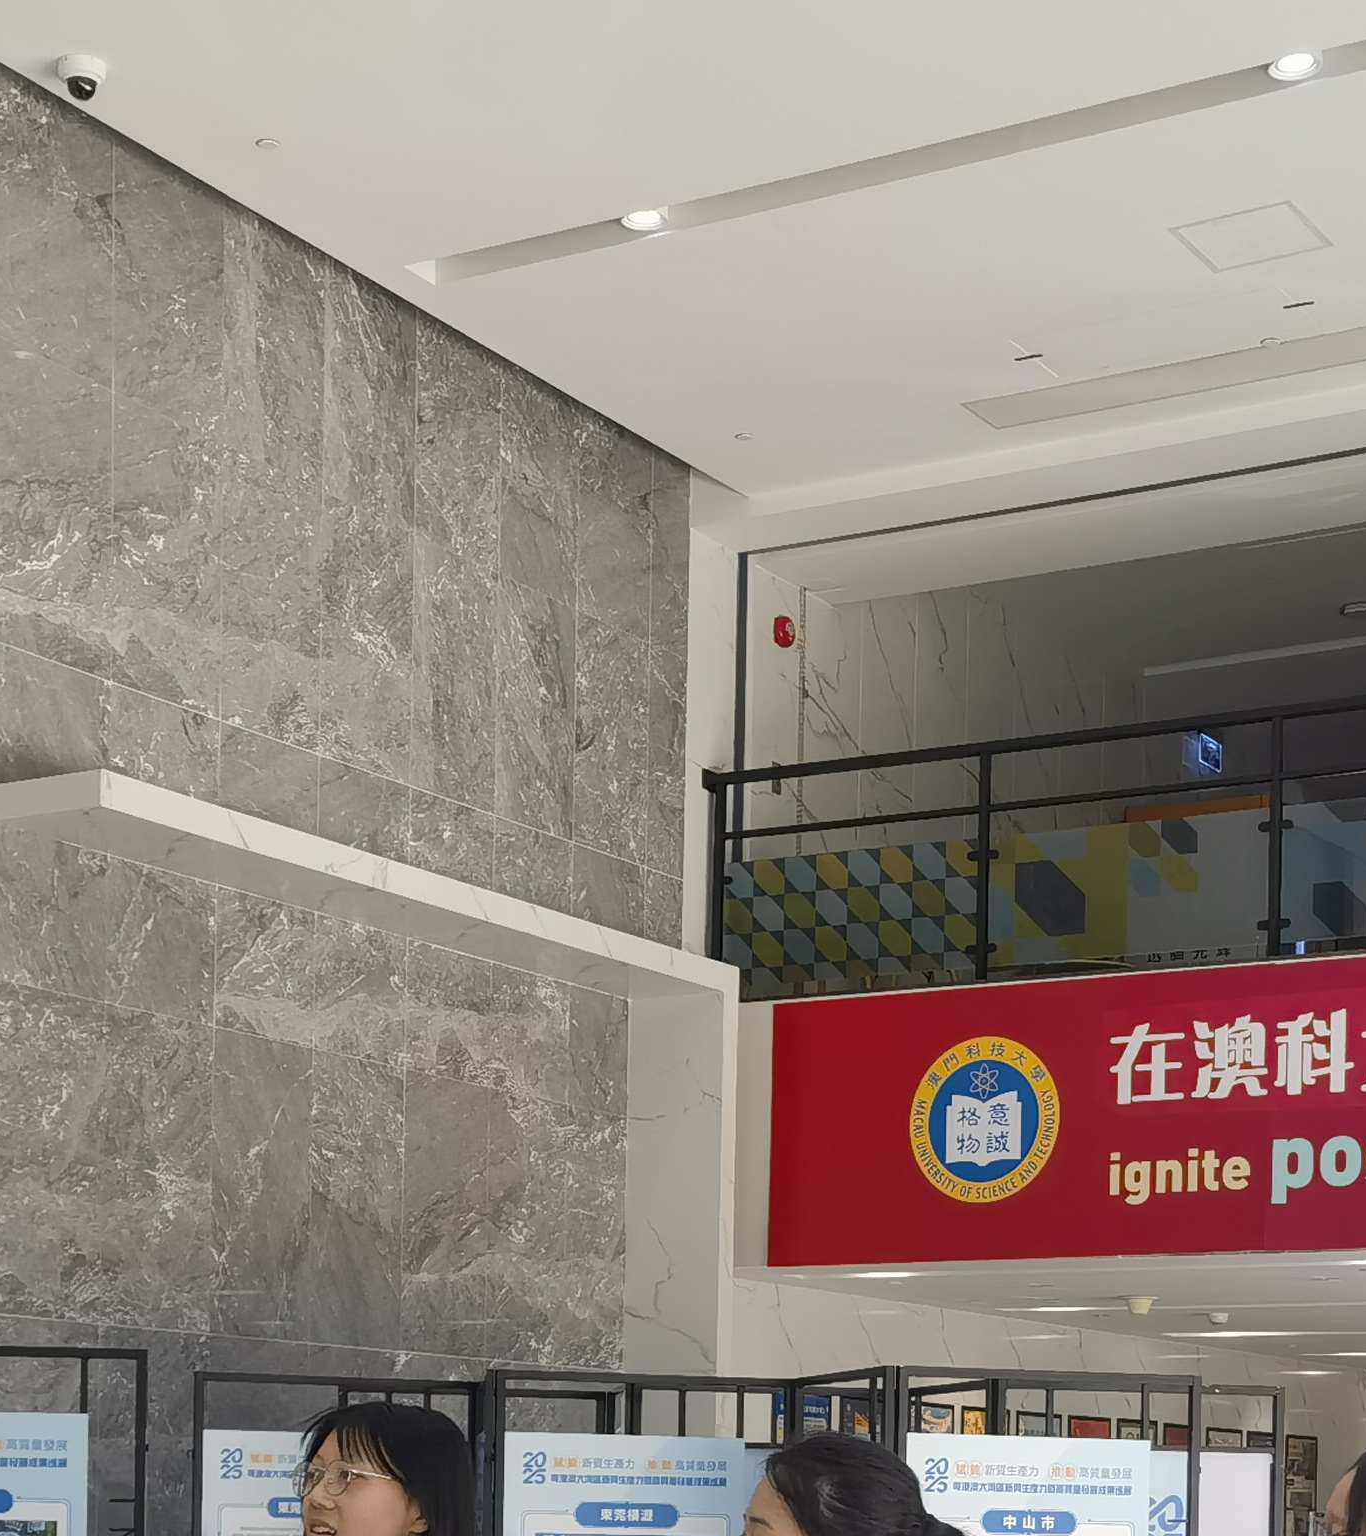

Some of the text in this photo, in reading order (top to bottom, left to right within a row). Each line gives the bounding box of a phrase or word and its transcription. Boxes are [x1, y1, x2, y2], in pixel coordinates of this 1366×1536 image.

[925, 1042, 1046, 1090] 澳門科技大學
[913, 1088, 1056, 1199] MACAU UNIVERSITY OF SCIENCE AND TECHNOLOGY
[1109, 1148, 1251, 1205] ignite
[1002, 1515, 1055, 1531] 中山市
